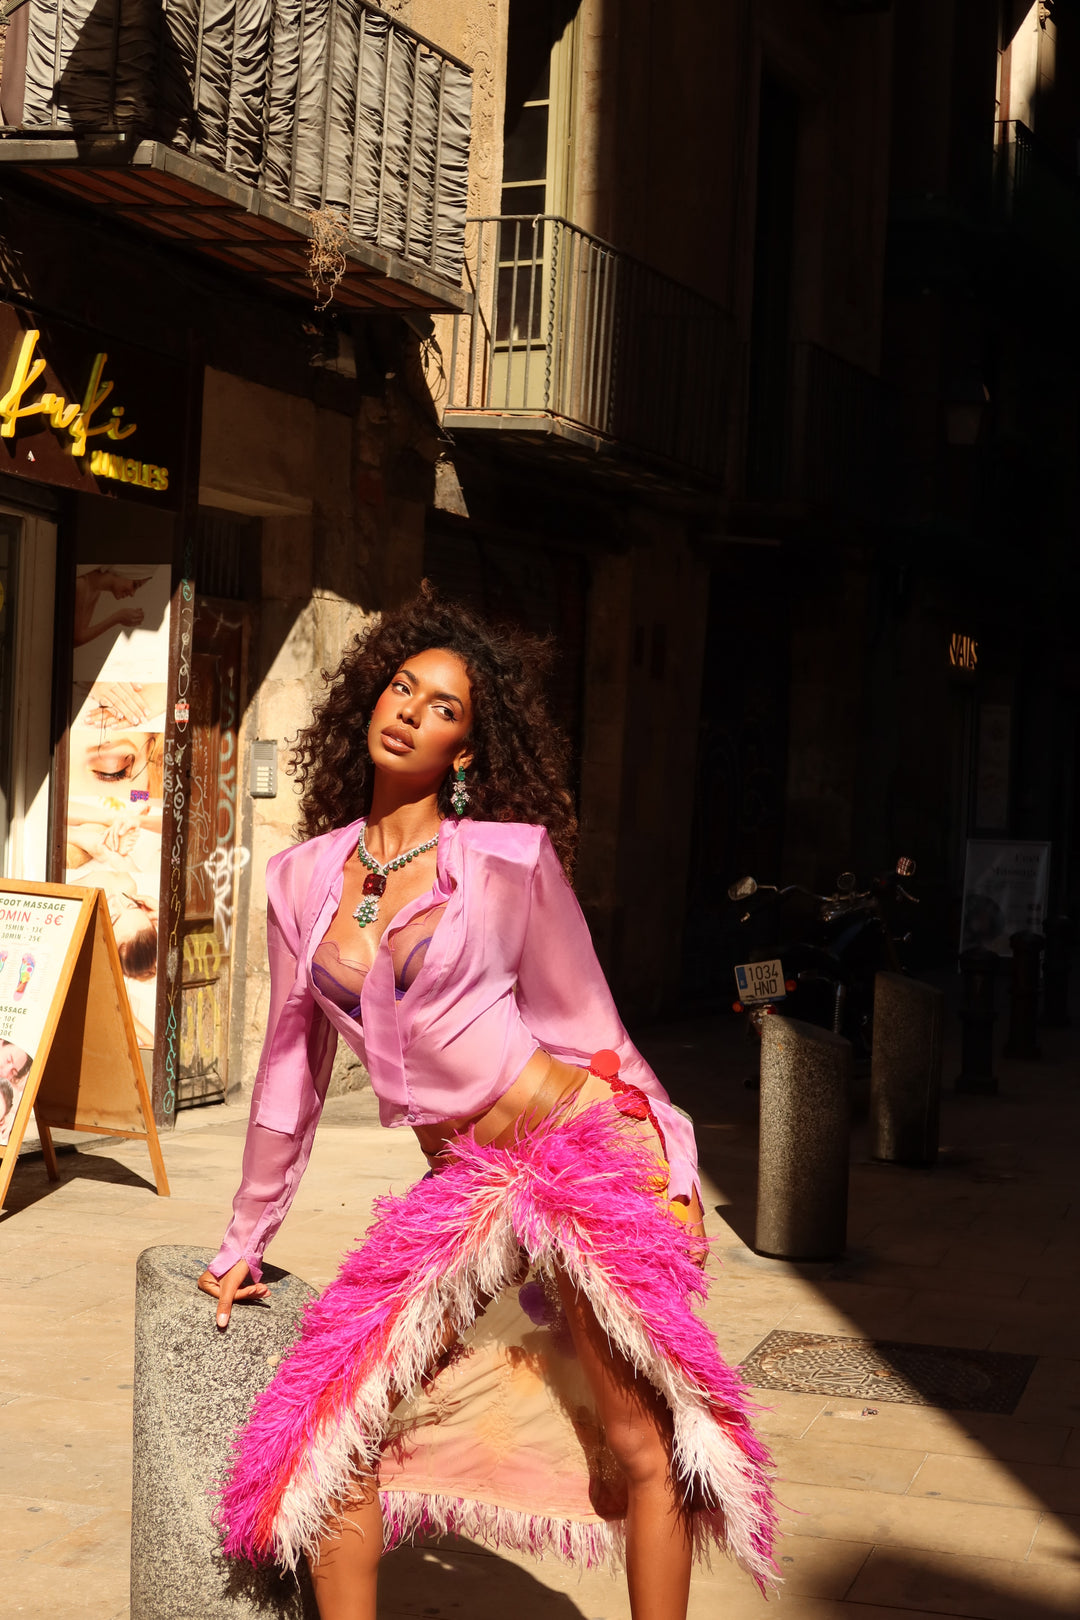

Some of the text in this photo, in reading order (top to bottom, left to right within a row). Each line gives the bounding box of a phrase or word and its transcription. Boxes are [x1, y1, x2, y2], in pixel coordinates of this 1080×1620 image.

[949, 632, 978, 670] NAILS
[23, 901, 66, 911] MASSAGE
[45, 913, 64, 926] 8€
[749, 963, 779, 981] 1034
[754, 979, 777, 996] HND
